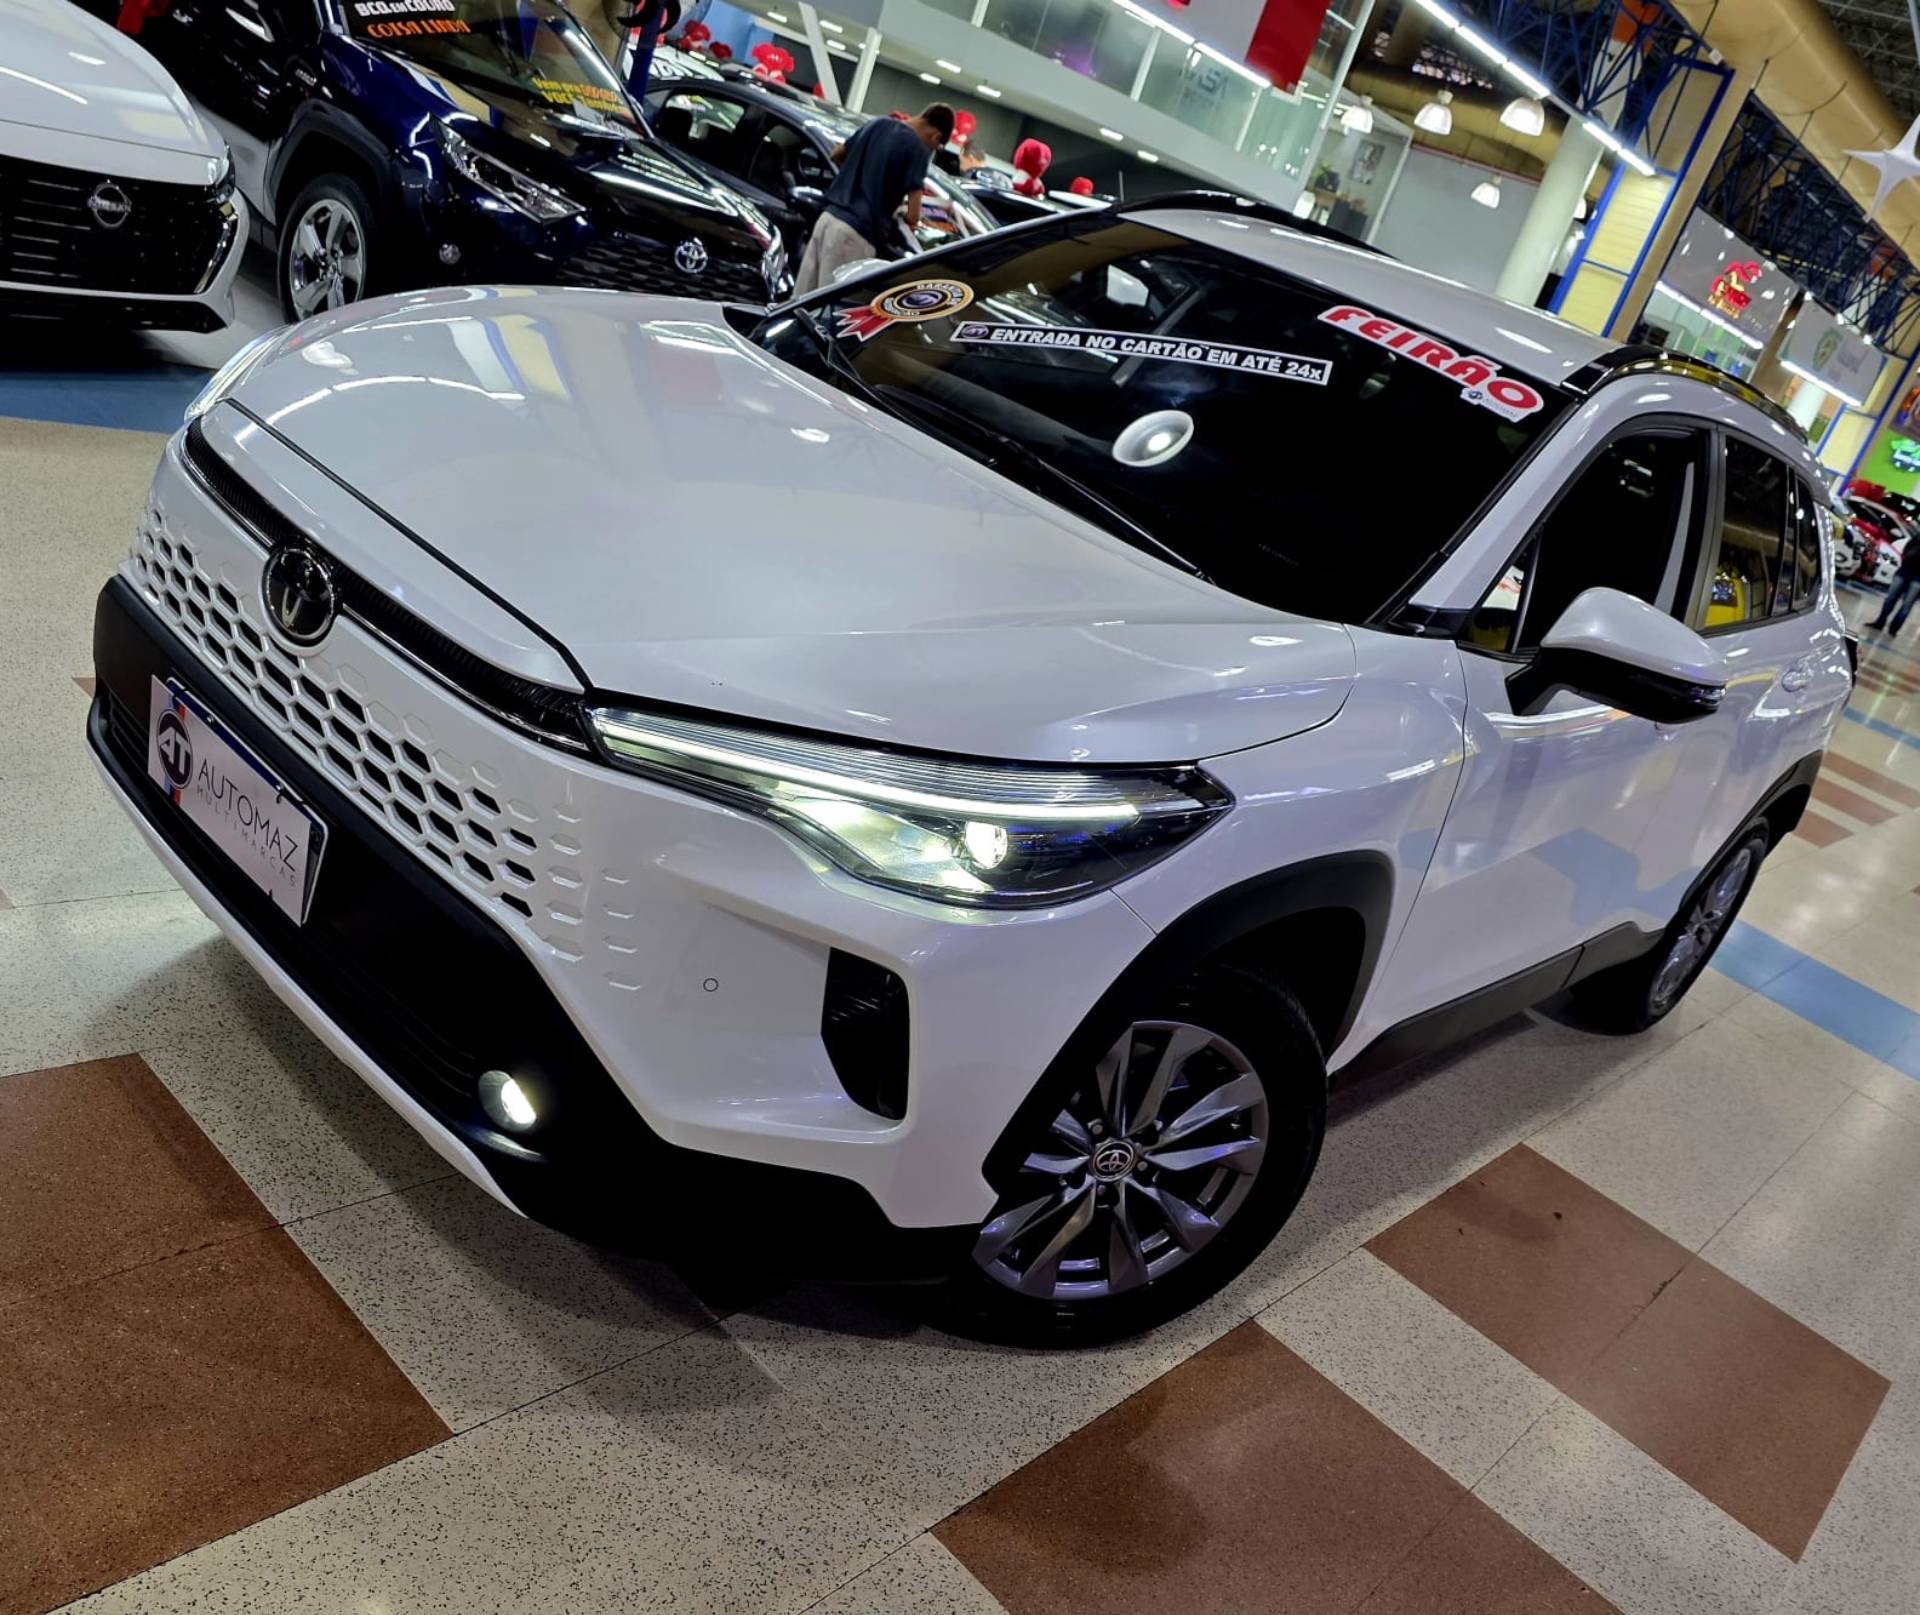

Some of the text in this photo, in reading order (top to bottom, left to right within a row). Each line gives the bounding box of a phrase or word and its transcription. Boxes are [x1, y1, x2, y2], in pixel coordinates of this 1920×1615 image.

[990, 328, 1081, 347] ENTRADA
[1086, 336, 1117, 349] NO
[1120, 339, 1203, 360] CARTÃO
[1207, 349, 1238, 365] EM
[1241, 354, 1282, 373] ATÉ
[1285, 361, 1323, 380] 24x
[1324, 307, 1538, 410] FEIRÃO
[198, 758, 298, 872] AUTOMAZ
